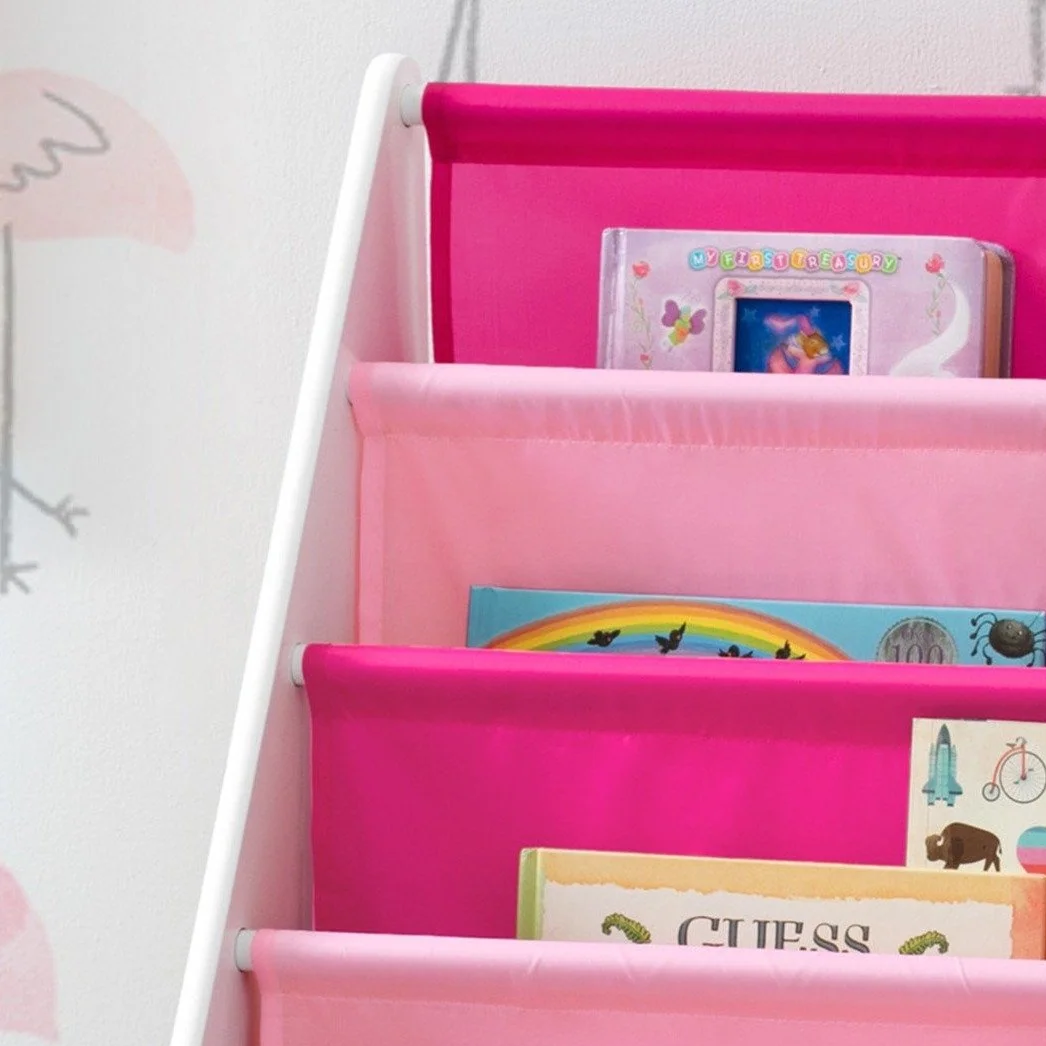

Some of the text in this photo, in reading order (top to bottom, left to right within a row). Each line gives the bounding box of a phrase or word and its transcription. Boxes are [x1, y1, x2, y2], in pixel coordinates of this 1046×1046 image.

[690, 248, 898, 273] MY FIRST TREASURY
[677, 915, 871, 954] GUESS
